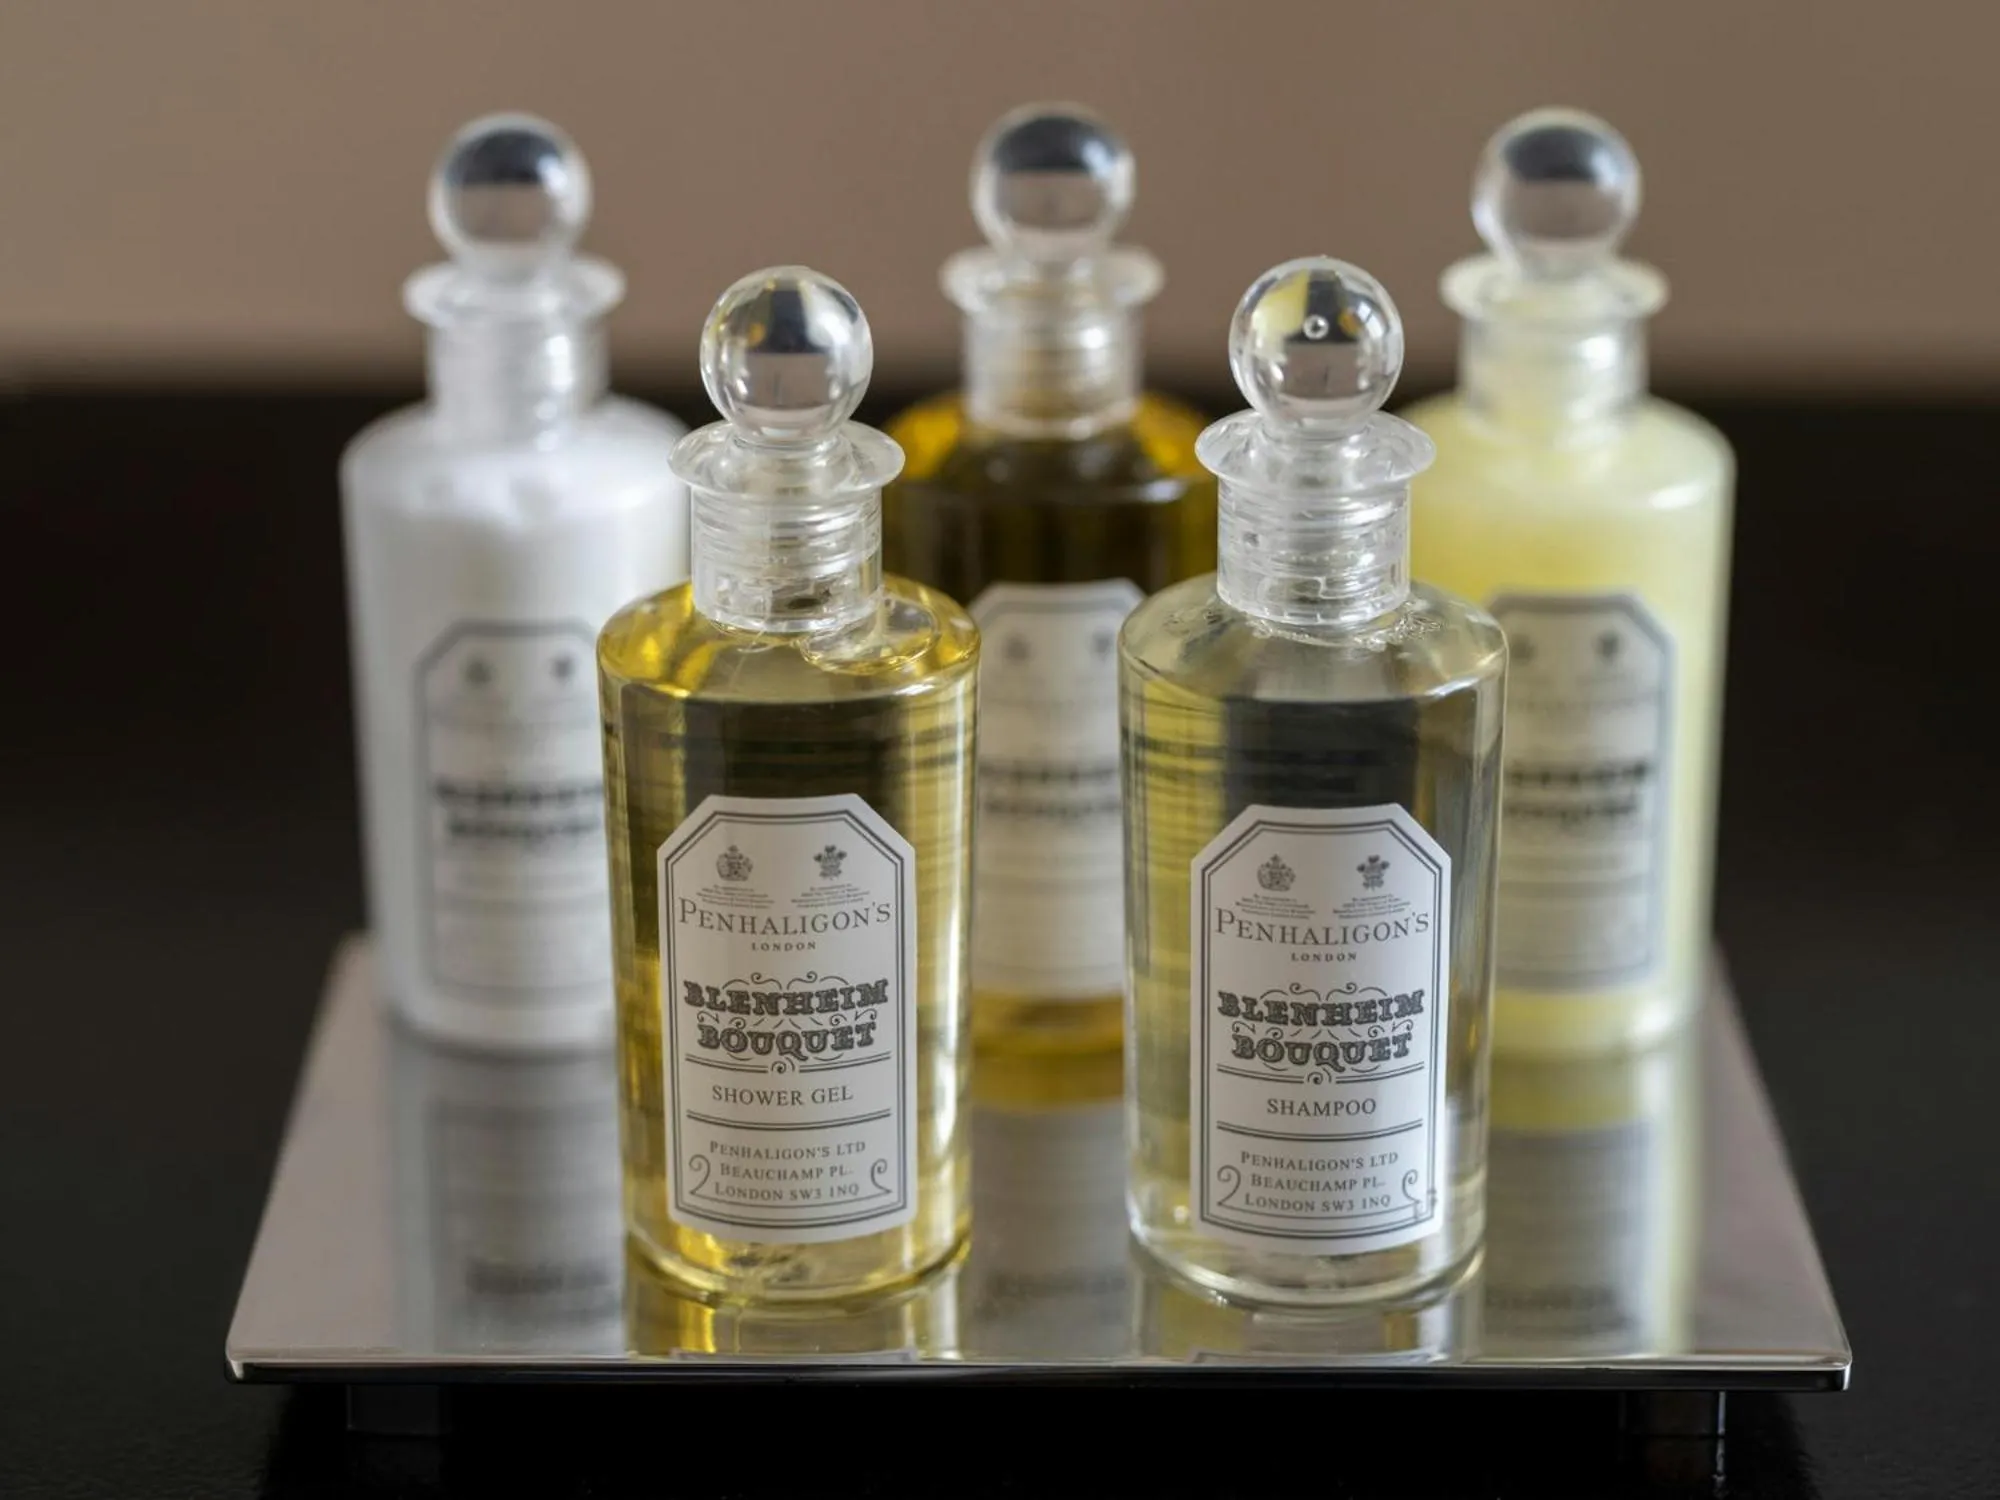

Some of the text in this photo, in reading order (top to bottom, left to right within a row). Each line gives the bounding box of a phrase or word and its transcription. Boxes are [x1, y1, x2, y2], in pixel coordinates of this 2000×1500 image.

[678, 898, 891, 935] PENHALIGON'S
[1215, 907, 1429, 946] PENHALIGON'S
[752, 941, 817, 952] LONDON
[1291, 952, 1357, 962] LONDON
[684, 979, 888, 1016] BLENHEIM
[1217, 989, 1424, 1026] BLENHEIM
[697, 1021, 876, 1061] BOUQUET
[1231, 1032, 1412, 1073] BOUQUET
[712, 1085, 854, 1106] SHOWER GEL
[1267, 1098, 1377, 1117] SHAMPOO
[710, 1140, 866, 1160] PENHALIGON'S LTD
[1241, 1151, 1398, 1171] PENHALIGON'S LTD
[720, 1162, 824, 1181] BEAUCHAMP
[715, 1182, 783, 1201] LONDON
[789, 1187, 821, 1201] SW3
[1251, 1173, 1357, 1192] BEAUCHAMP
[1245, 1193, 1315, 1212] LONDON
[1321, 1199, 1354, 1212] SW3
